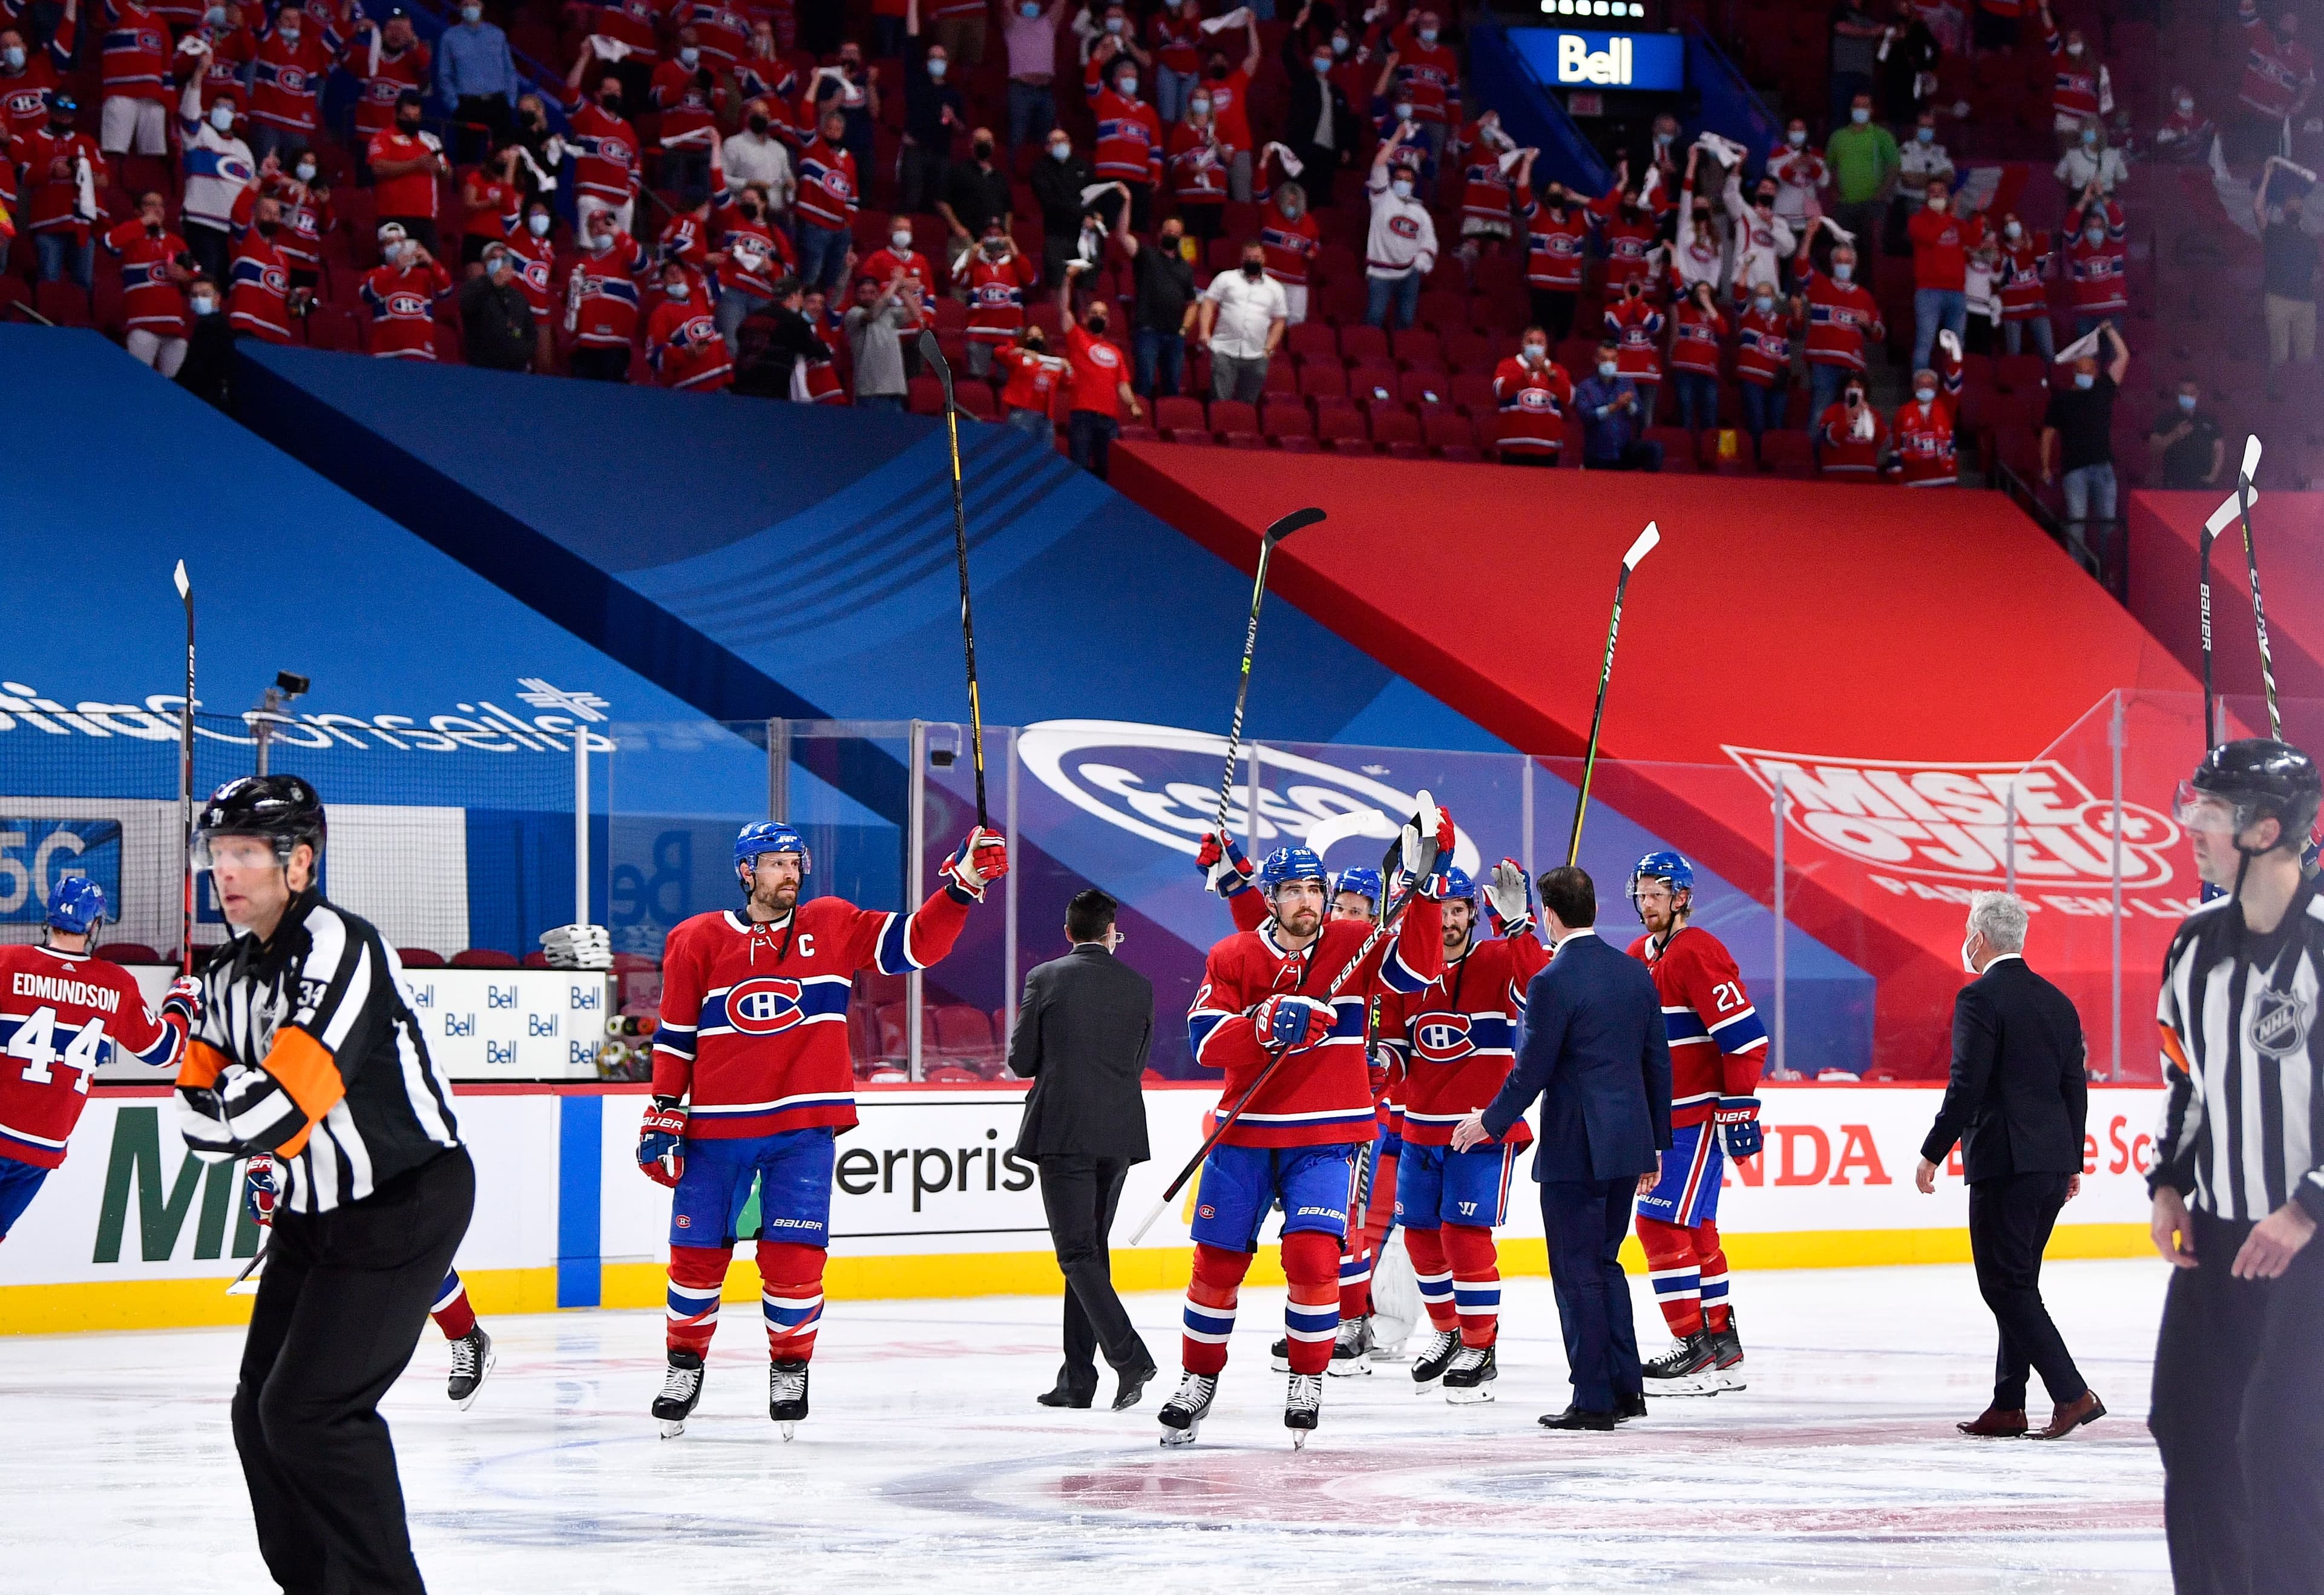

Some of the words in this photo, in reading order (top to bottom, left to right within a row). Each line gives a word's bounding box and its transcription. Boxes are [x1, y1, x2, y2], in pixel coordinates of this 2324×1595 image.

[1558, 35, 1632, 84] Bell
[1753, 758, 2083, 825] MISE
[798, 933, 815, 957] C
[12, 972, 120, 1014] EDMUNDSON
[488, 985, 517, 1008] Bell
[571, 986, 600, 1009] Bell
[1712, 981, 1745, 1013] 21
[445, 1013, 475, 1036] Bell
[529, 1013, 558, 1036] Bell
[2259, 1006, 2293, 1041] NHL
[7, 1005, 105, 1095] 44
[487, 1040, 517, 1064] Bell
[570, 1040, 599, 1064] Bell
